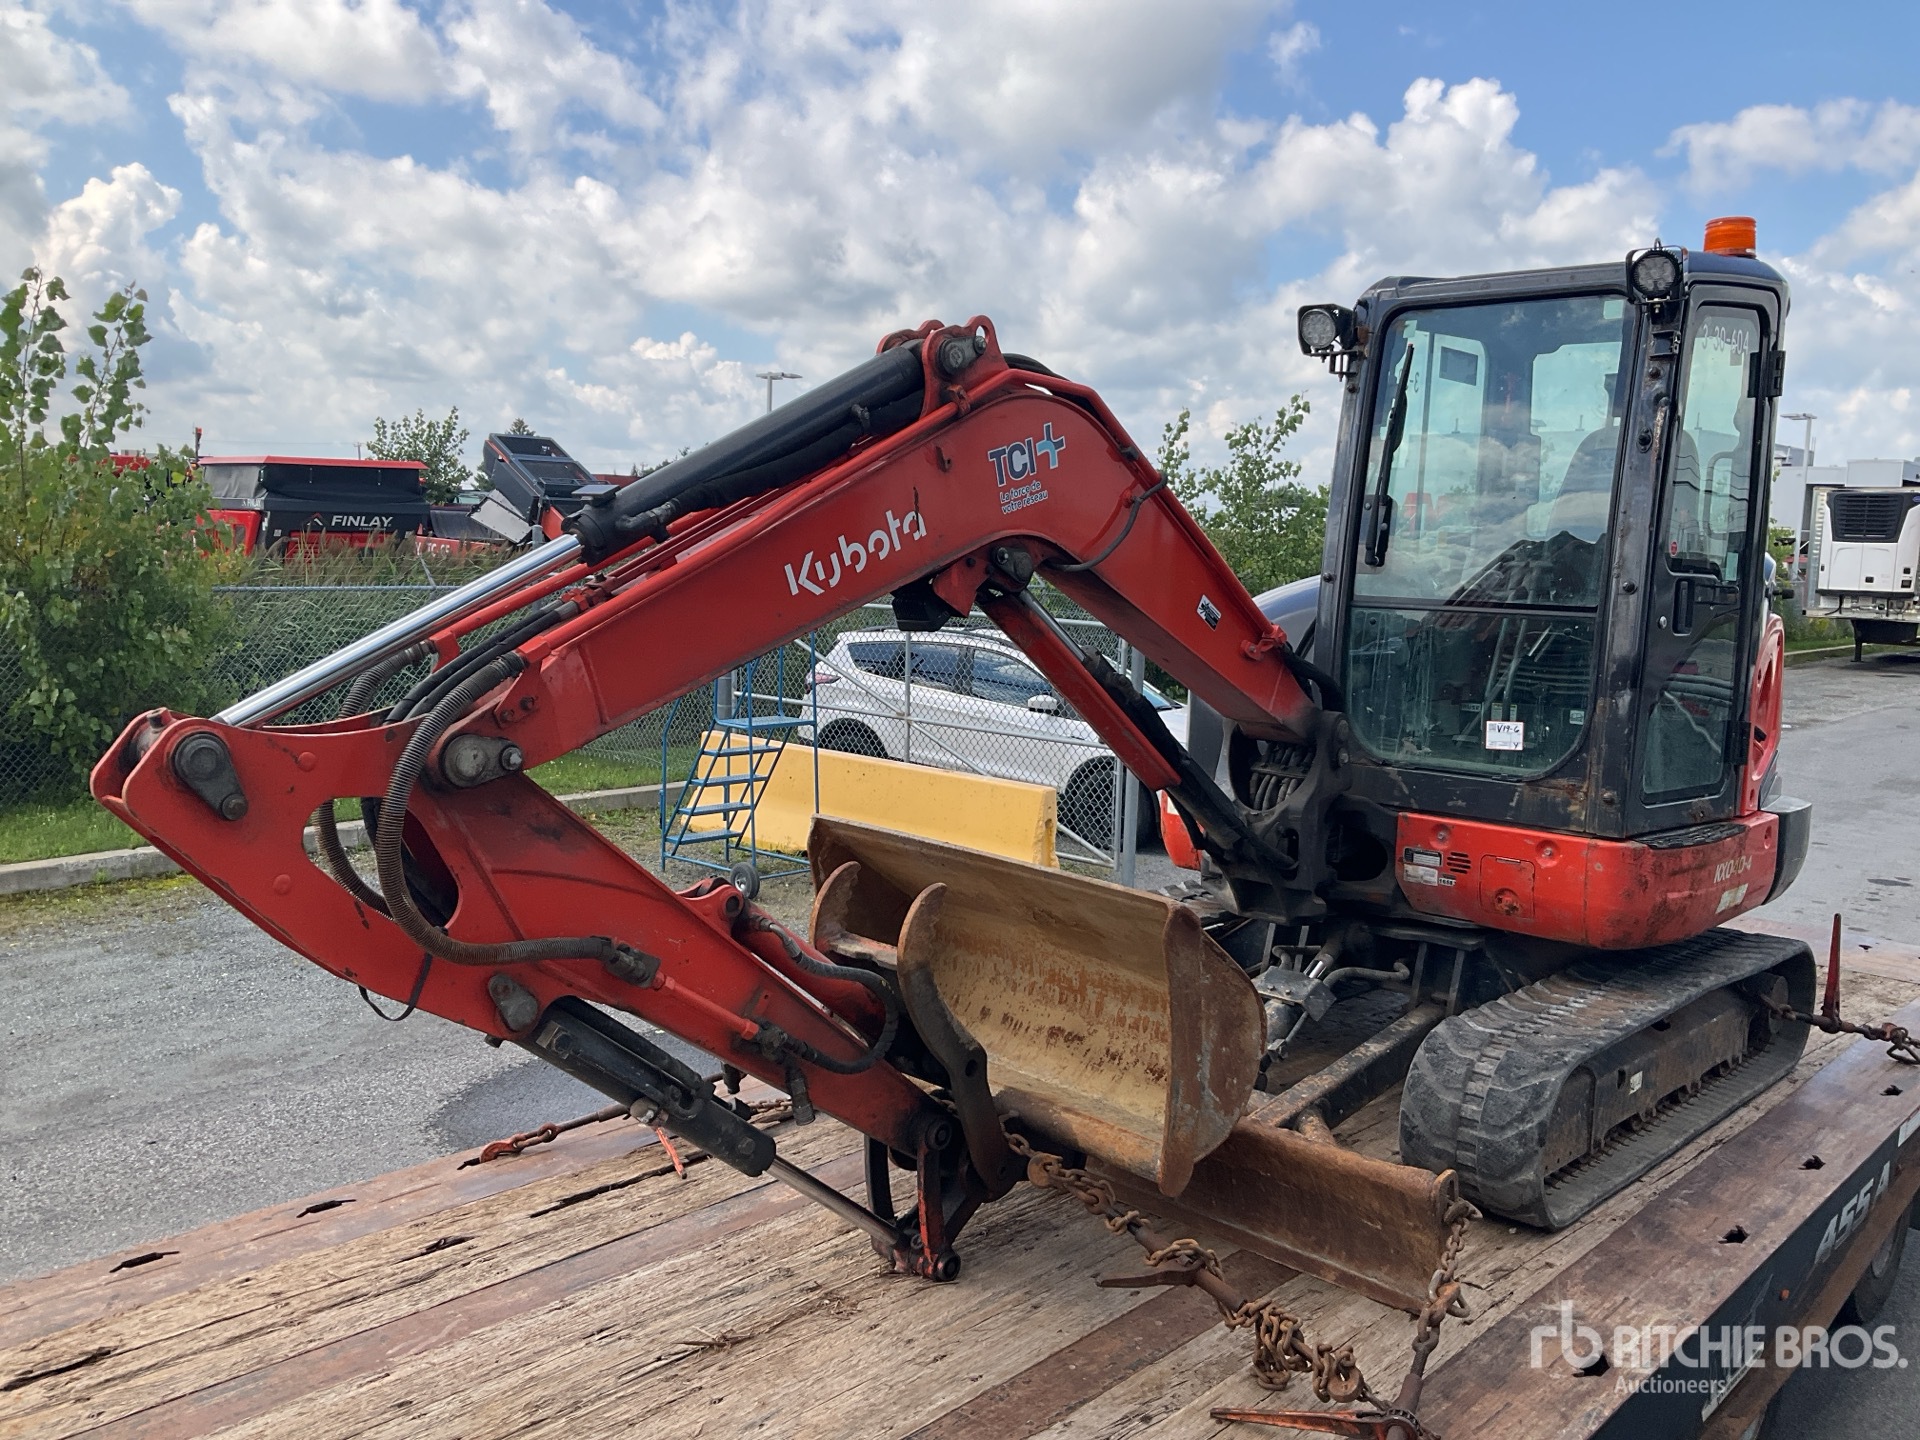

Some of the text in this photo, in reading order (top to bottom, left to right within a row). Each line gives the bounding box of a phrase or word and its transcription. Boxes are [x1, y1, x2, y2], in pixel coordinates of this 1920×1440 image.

[1000, 480, 1041, 503] La force de
[1002, 500, 1022, 514] votre
[331, 515, 393, 528] FINLAY
[784, 510, 927, 596] Kubota
[1814, 1160, 1890, 1264] 455 A
